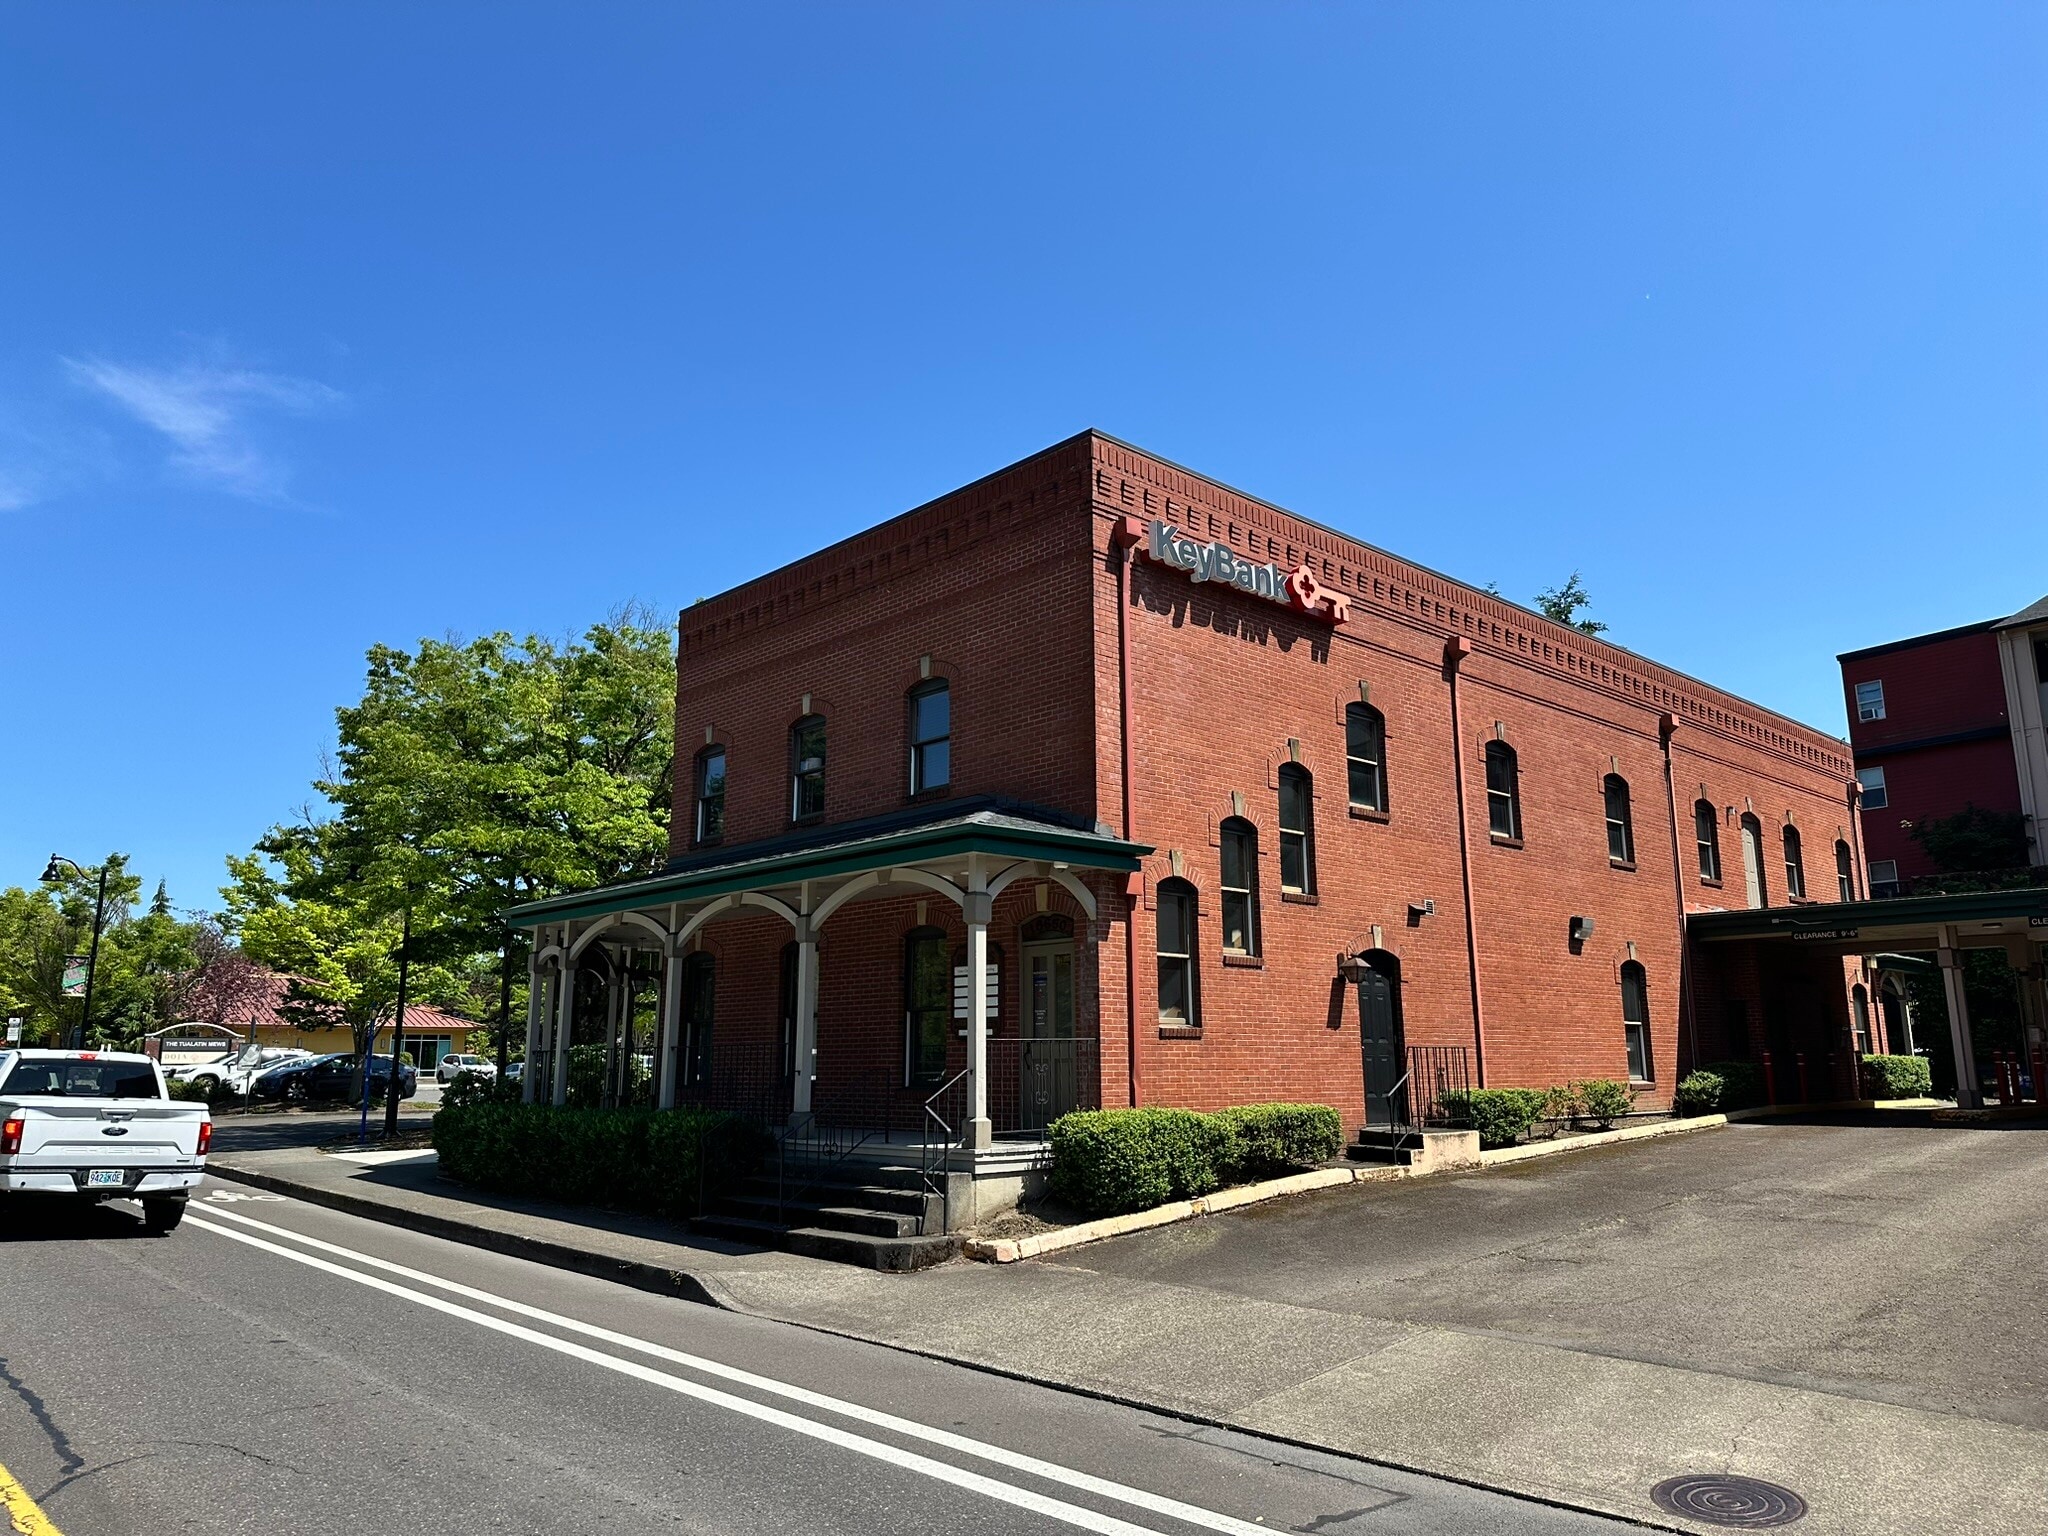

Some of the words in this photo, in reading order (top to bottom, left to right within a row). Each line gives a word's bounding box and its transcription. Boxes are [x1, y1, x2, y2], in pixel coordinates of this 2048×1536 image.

[1149, 520, 1290, 603] KeyBank
[1793, 931, 1837, 940] CLEARANCE
[90, 1173, 104, 1183] 942
